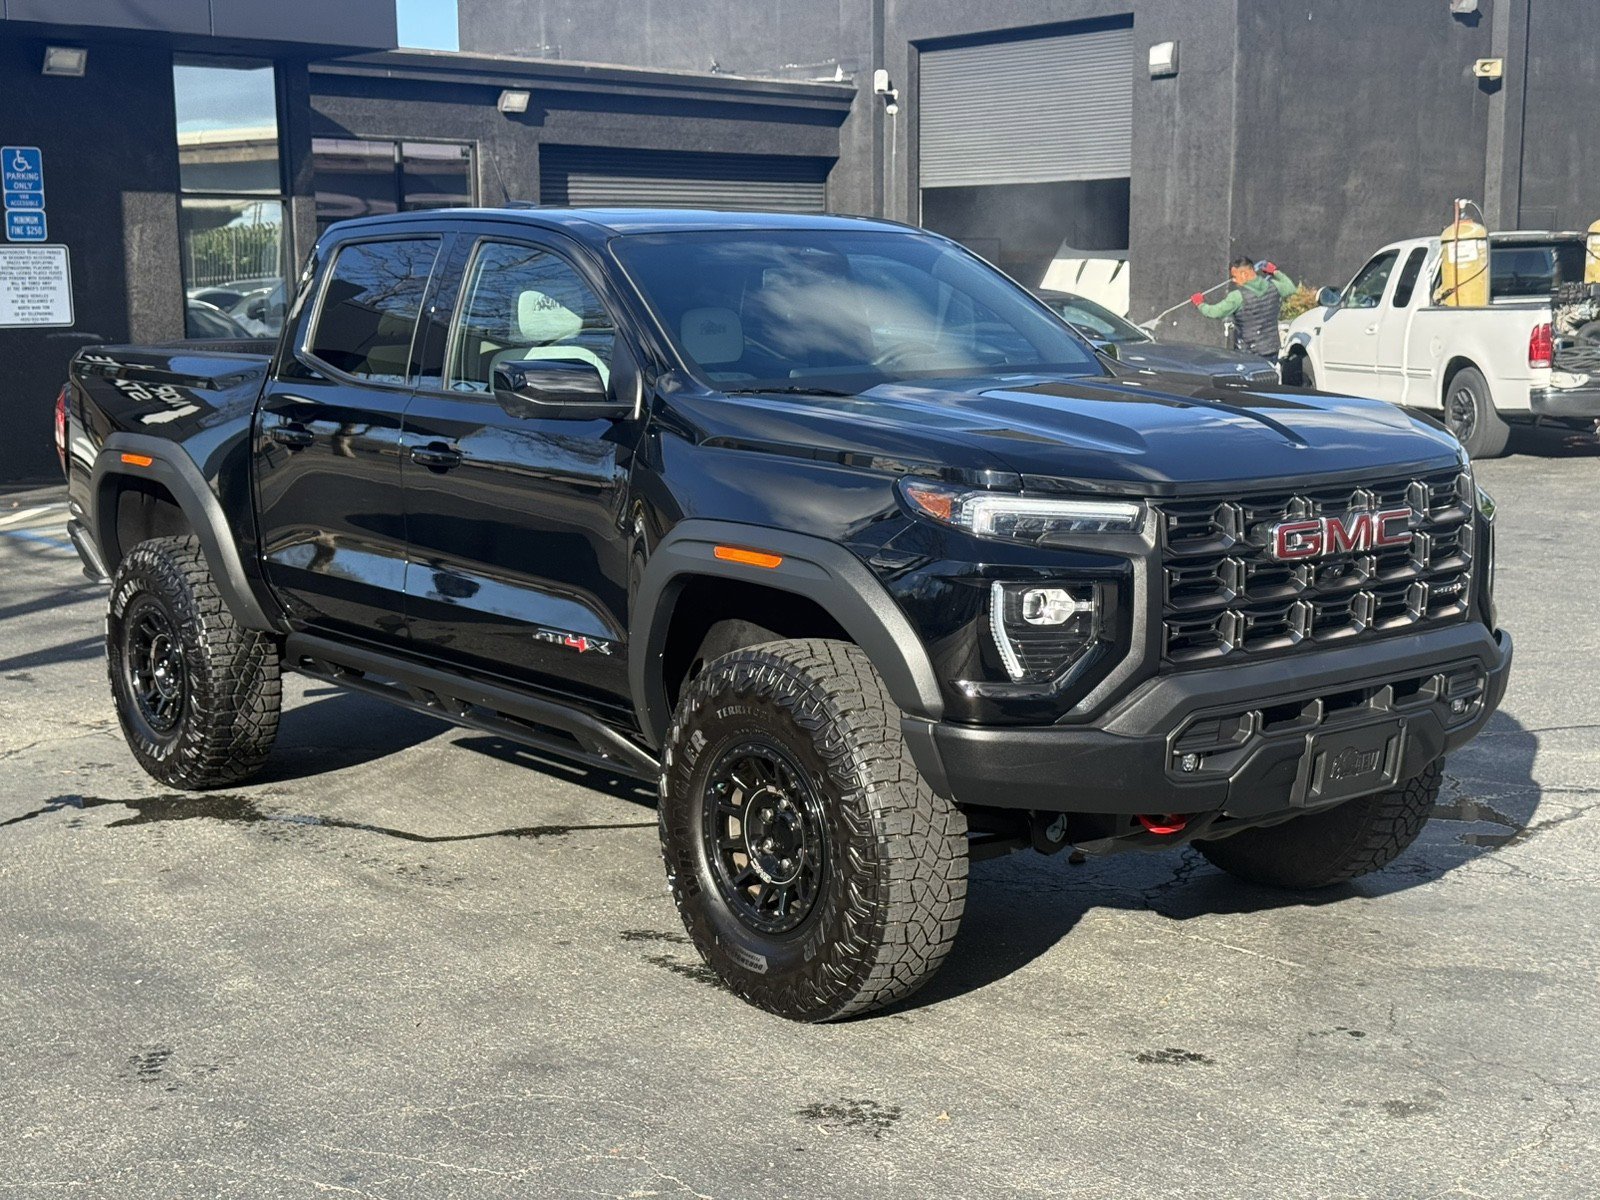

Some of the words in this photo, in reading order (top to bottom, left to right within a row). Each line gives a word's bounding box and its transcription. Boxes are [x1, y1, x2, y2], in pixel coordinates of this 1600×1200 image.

[6, 172, 39, 180] PARKING
[13, 182, 33, 190] ONLY
[13, 216, 39, 225] MINIMUM
[11, 225, 25, 235] FINE
[26, 225, 43, 236] $250
[1272, 507, 1413, 560] GMC
[671, 728, 709, 898] WRANGLER
